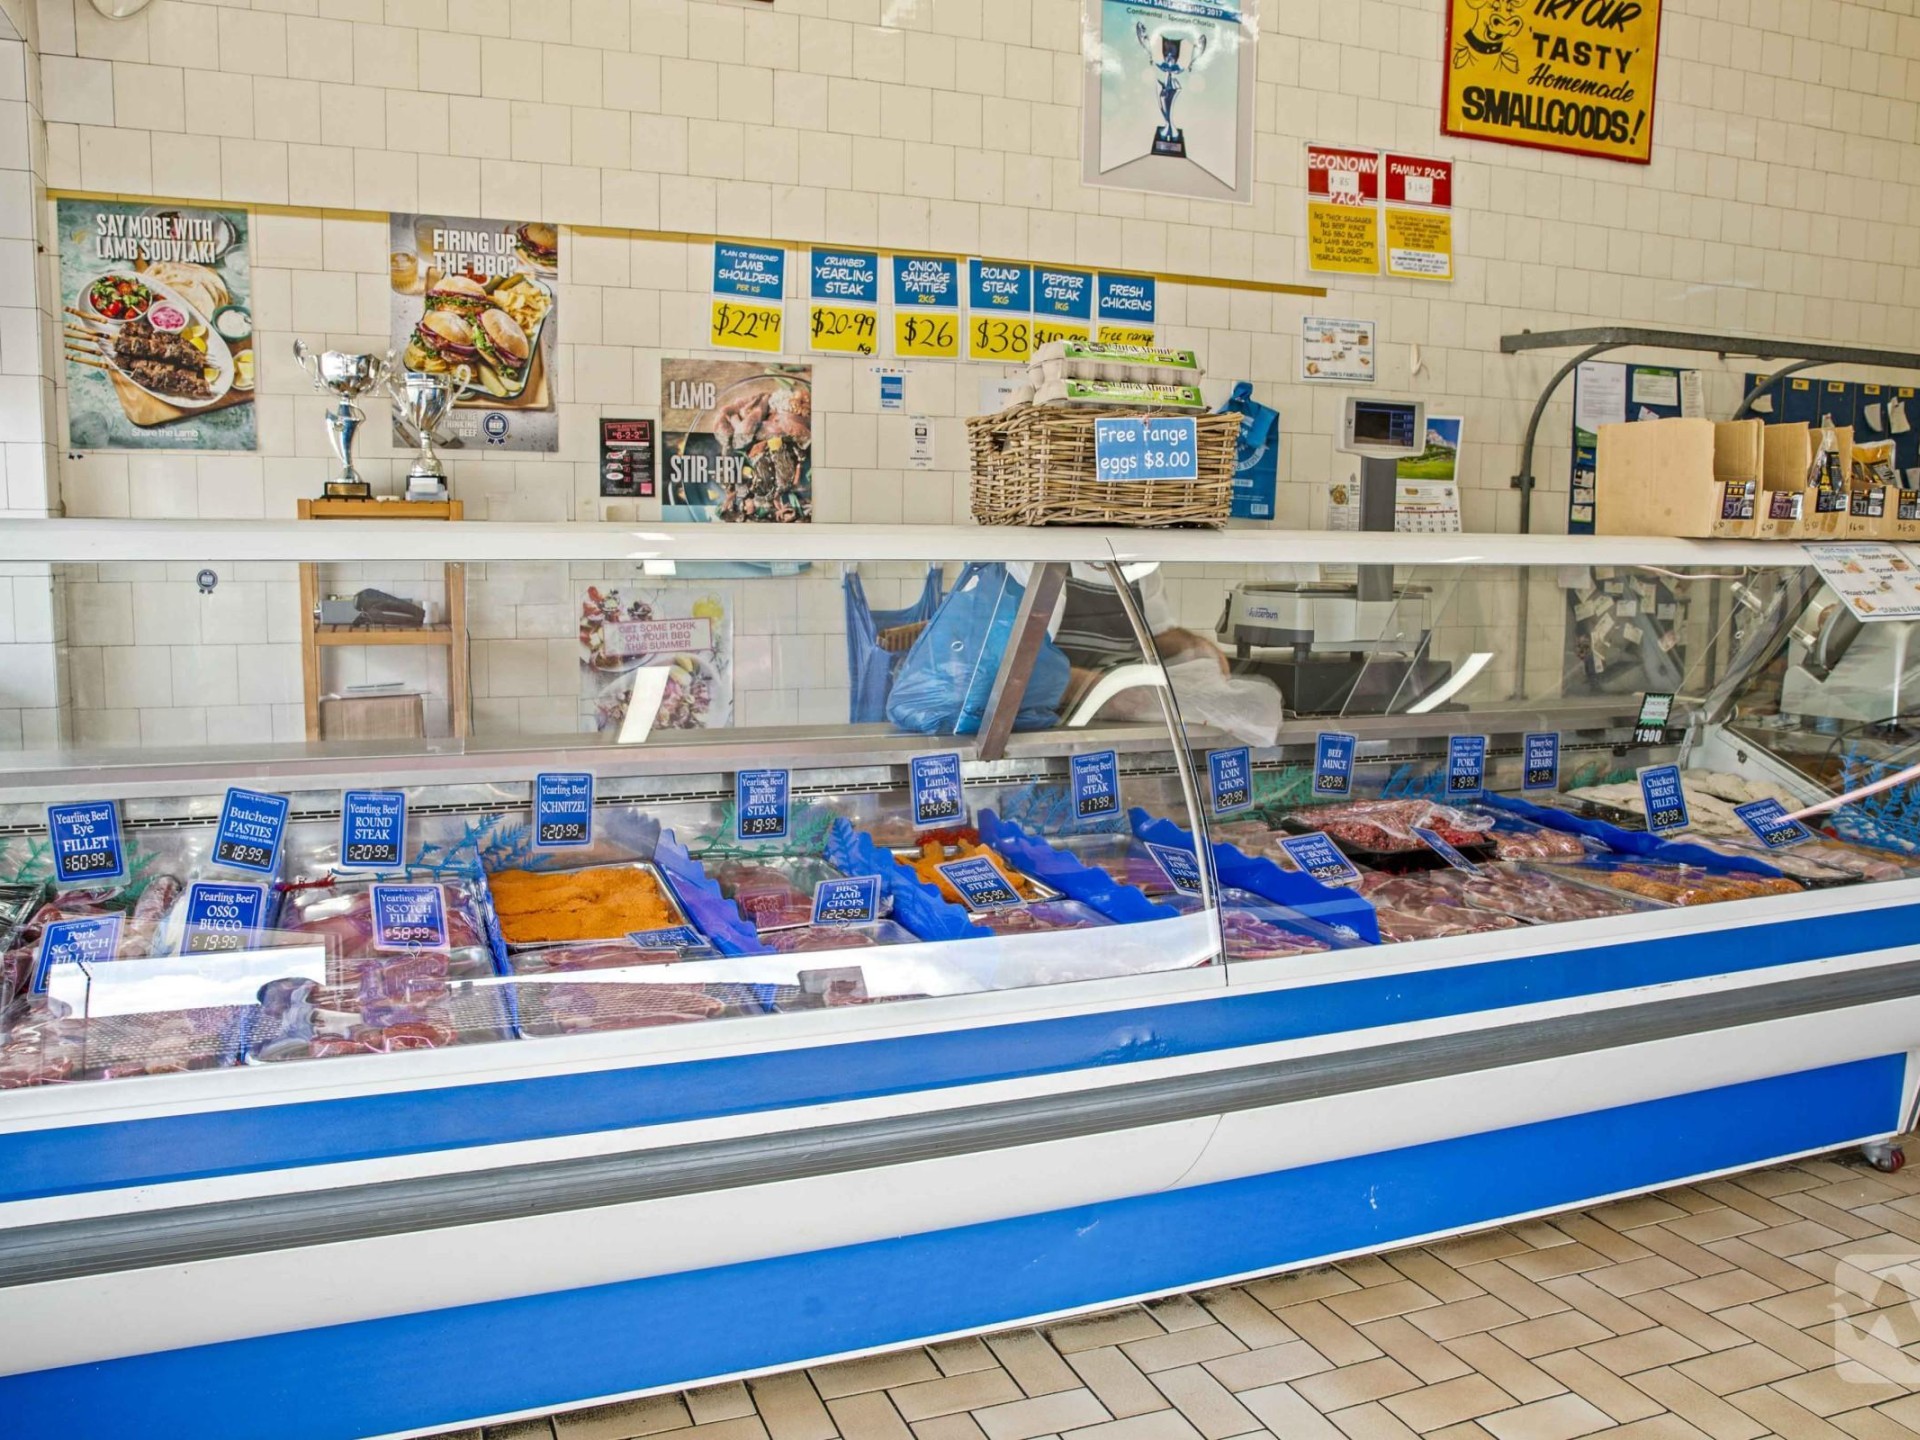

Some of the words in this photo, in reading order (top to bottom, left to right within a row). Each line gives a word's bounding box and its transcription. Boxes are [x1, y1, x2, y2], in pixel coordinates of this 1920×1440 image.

[1126, 7, 1162, 19] Continental
[1206, 8, 1224, 17] 2017
[1581, 0, 1642, 33] OUR
[1527, 63, 1635, 102] Homemade
[1461, 86, 1646, 145] SMALLGOODS!
[1308, 153, 1378, 174] ECONOMY
[1390, 163, 1423, 177] FAMILY
[1424, 167, 1447, 180] PACK
[1330, 191, 1365, 207] PACK
[96, 213, 125, 237] SAY
[128, 216, 171, 239] MORE
[173, 217, 213, 241] WITH
[433, 228, 490, 253] FIRING
[494, 232, 517, 255] UP
[96, 235, 138, 260] LAMB
[140, 239, 216, 263] SOUVLAKI
[433, 251, 469, 275] THE
[473, 253, 517, 278] BBQ?
[734, 259, 764, 272] LAMB
[823, 256, 866, 268] CRUMBED
[908, 260, 943, 272] ONION
[718, 268, 779, 285] SHOULDERS
[815, 266, 874, 282] YEARLING
[901, 270, 950, 283] SAUSAGE
[980, 266, 1020, 280] ROUND
[982, 280, 1018, 294] STEAK
[1042, 272, 1084, 289] PEPPER
[824, 282, 864, 296] STEAK
[905, 282, 947, 294] PATTIES
[1044, 286, 1080, 302] STEAK
[1109, 284, 1144, 298] FRESH
[918, 294, 936, 304] 2KG
[992, 295, 1009, 305] 2KG
[1100, 296, 1152, 312] CHICKENS
[903, 316, 953, 347] $26
[976, 319, 1028, 353] $38
[1099, 326, 1122, 341] Free
[1126, 332, 1154, 347] range
[670, 381, 716, 410] LAMB
[131, 428, 157, 437] Share
[158, 428, 173, 438] the
[174, 428, 199, 439] Lamb
[459, 428, 478, 437] BEEF
[1099, 427, 1136, 443] Free
[1143, 428, 1188, 447] range
[670, 454, 745, 484] STIR-FRY
[1100, 456, 1137, 475] eggs
[1144, 450, 1190, 470] $8.00
[639, 623, 667, 634] SOME
[669, 621, 697, 631] PORK
[643, 632, 669, 641] YOUR
[671, 630, 692, 640] BBQ
[625, 643, 648, 653] THIS
[649, 639, 692, 651] SUMMER
[1327, 748, 1344, 758] BEEF
[1530, 749, 1554, 758] Chicken
[1221, 757, 1238, 769] Pork
[1322, 758, 1349, 770] MINCE
[1457, 757, 1476, 767] PORK
[917, 763, 955, 777] Crumbed
[1220, 768, 1240, 780] LOIN
[1453, 767, 1480, 776] RISSOLES
[742, 777, 770, 788] Yearling
[770, 777, 784, 785] Beef
[925, 776, 950, 788] Lamb
[1087, 772, 1103, 784] BBQ
[1218, 777, 1245, 791] CHOPS
[1646, 776, 1675, 788] Chicken
[541, 784, 571, 797] Yearling
[572, 784, 588, 794] Beef
[1082, 782, 1109, 796] STEAK
[1650, 784, 1675, 798] BREAST
[749, 793, 777, 804] BLADE
[1652, 796, 1679, 809] FILLETS
[350, 804, 382, 817] Yearling
[382, 804, 399, 815] Beef
[541, 800, 587, 813] SCHNITZEL
[747, 804, 778, 816] STEAK
[1745, 805, 1777, 819] Chicken
[56, 811, 91, 824] Yearling
[90, 809, 109, 821] Beef
[229, 806, 279, 826] Butchers
[355, 816, 393, 828] ROUND
[72, 823, 95, 837] Eye
[229, 820, 272, 839] PASTIES
[354, 828, 391, 840] STEAK
[62, 835, 109, 852] FILLET
[1298, 848, 1332, 860] T-BONE
[1306, 855, 1336, 867] STEAK
[65, 852, 106, 872] $60.99
[836, 885, 859, 893] BBQ
[966, 880, 998, 892] STEAK
[199, 891, 234, 905] Yearling
[235, 893, 255, 904] Beef
[381, 894, 415, 905] Yearling
[832, 890, 862, 900] LAMB
[385, 904, 432, 914] SCOTCH
[827, 898, 865, 908] CHOPS
[206, 904, 239, 918] OSSO
[199, 918, 242, 932] BUCCO
[389, 913, 430, 924] FILLET
[67, 928, 97, 941] Pork
[50, 937, 109, 956] SCOTCH
[55, 951, 100, 965] FILLET
